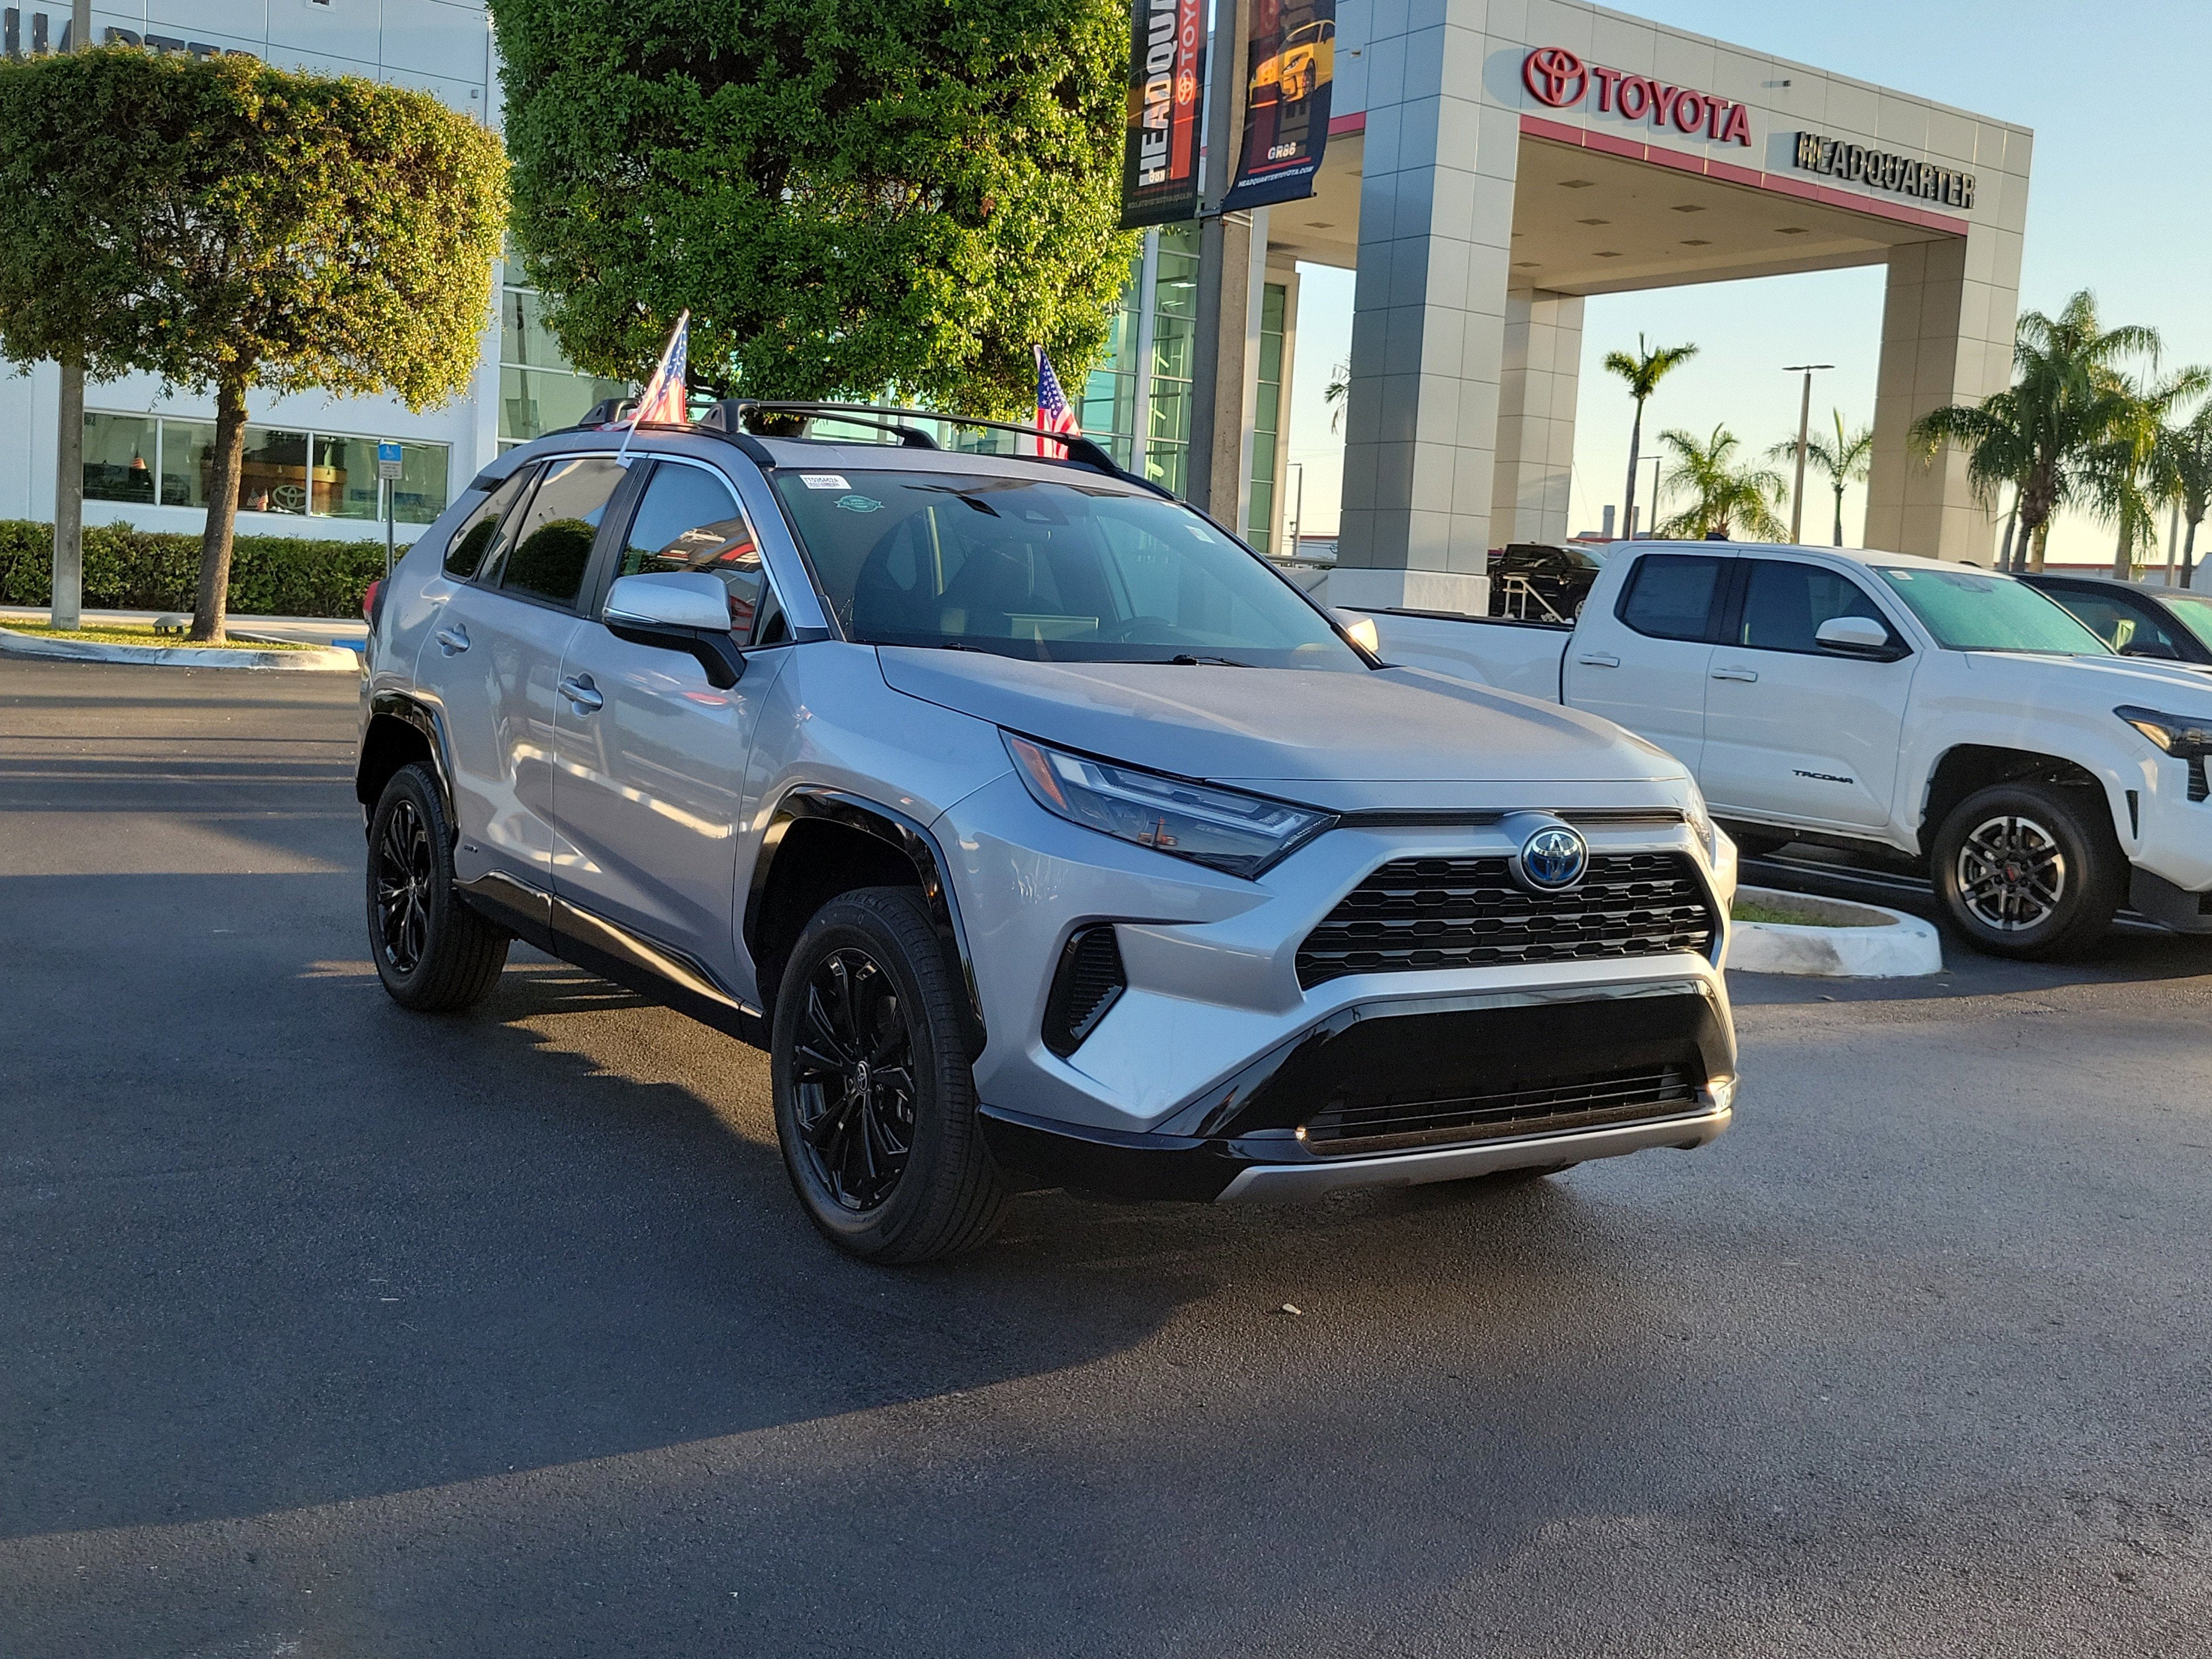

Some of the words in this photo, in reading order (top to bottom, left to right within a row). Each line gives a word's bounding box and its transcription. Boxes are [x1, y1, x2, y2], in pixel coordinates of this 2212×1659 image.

[1181, 0, 1196, 66] TOY
[1593, 67, 1751, 147] TOYOTA
[1267, 142, 1297, 160] GR86
[1797, 131, 1976, 209] HEADQUARTER
[1792, 769, 1853, 784] TACOMA
